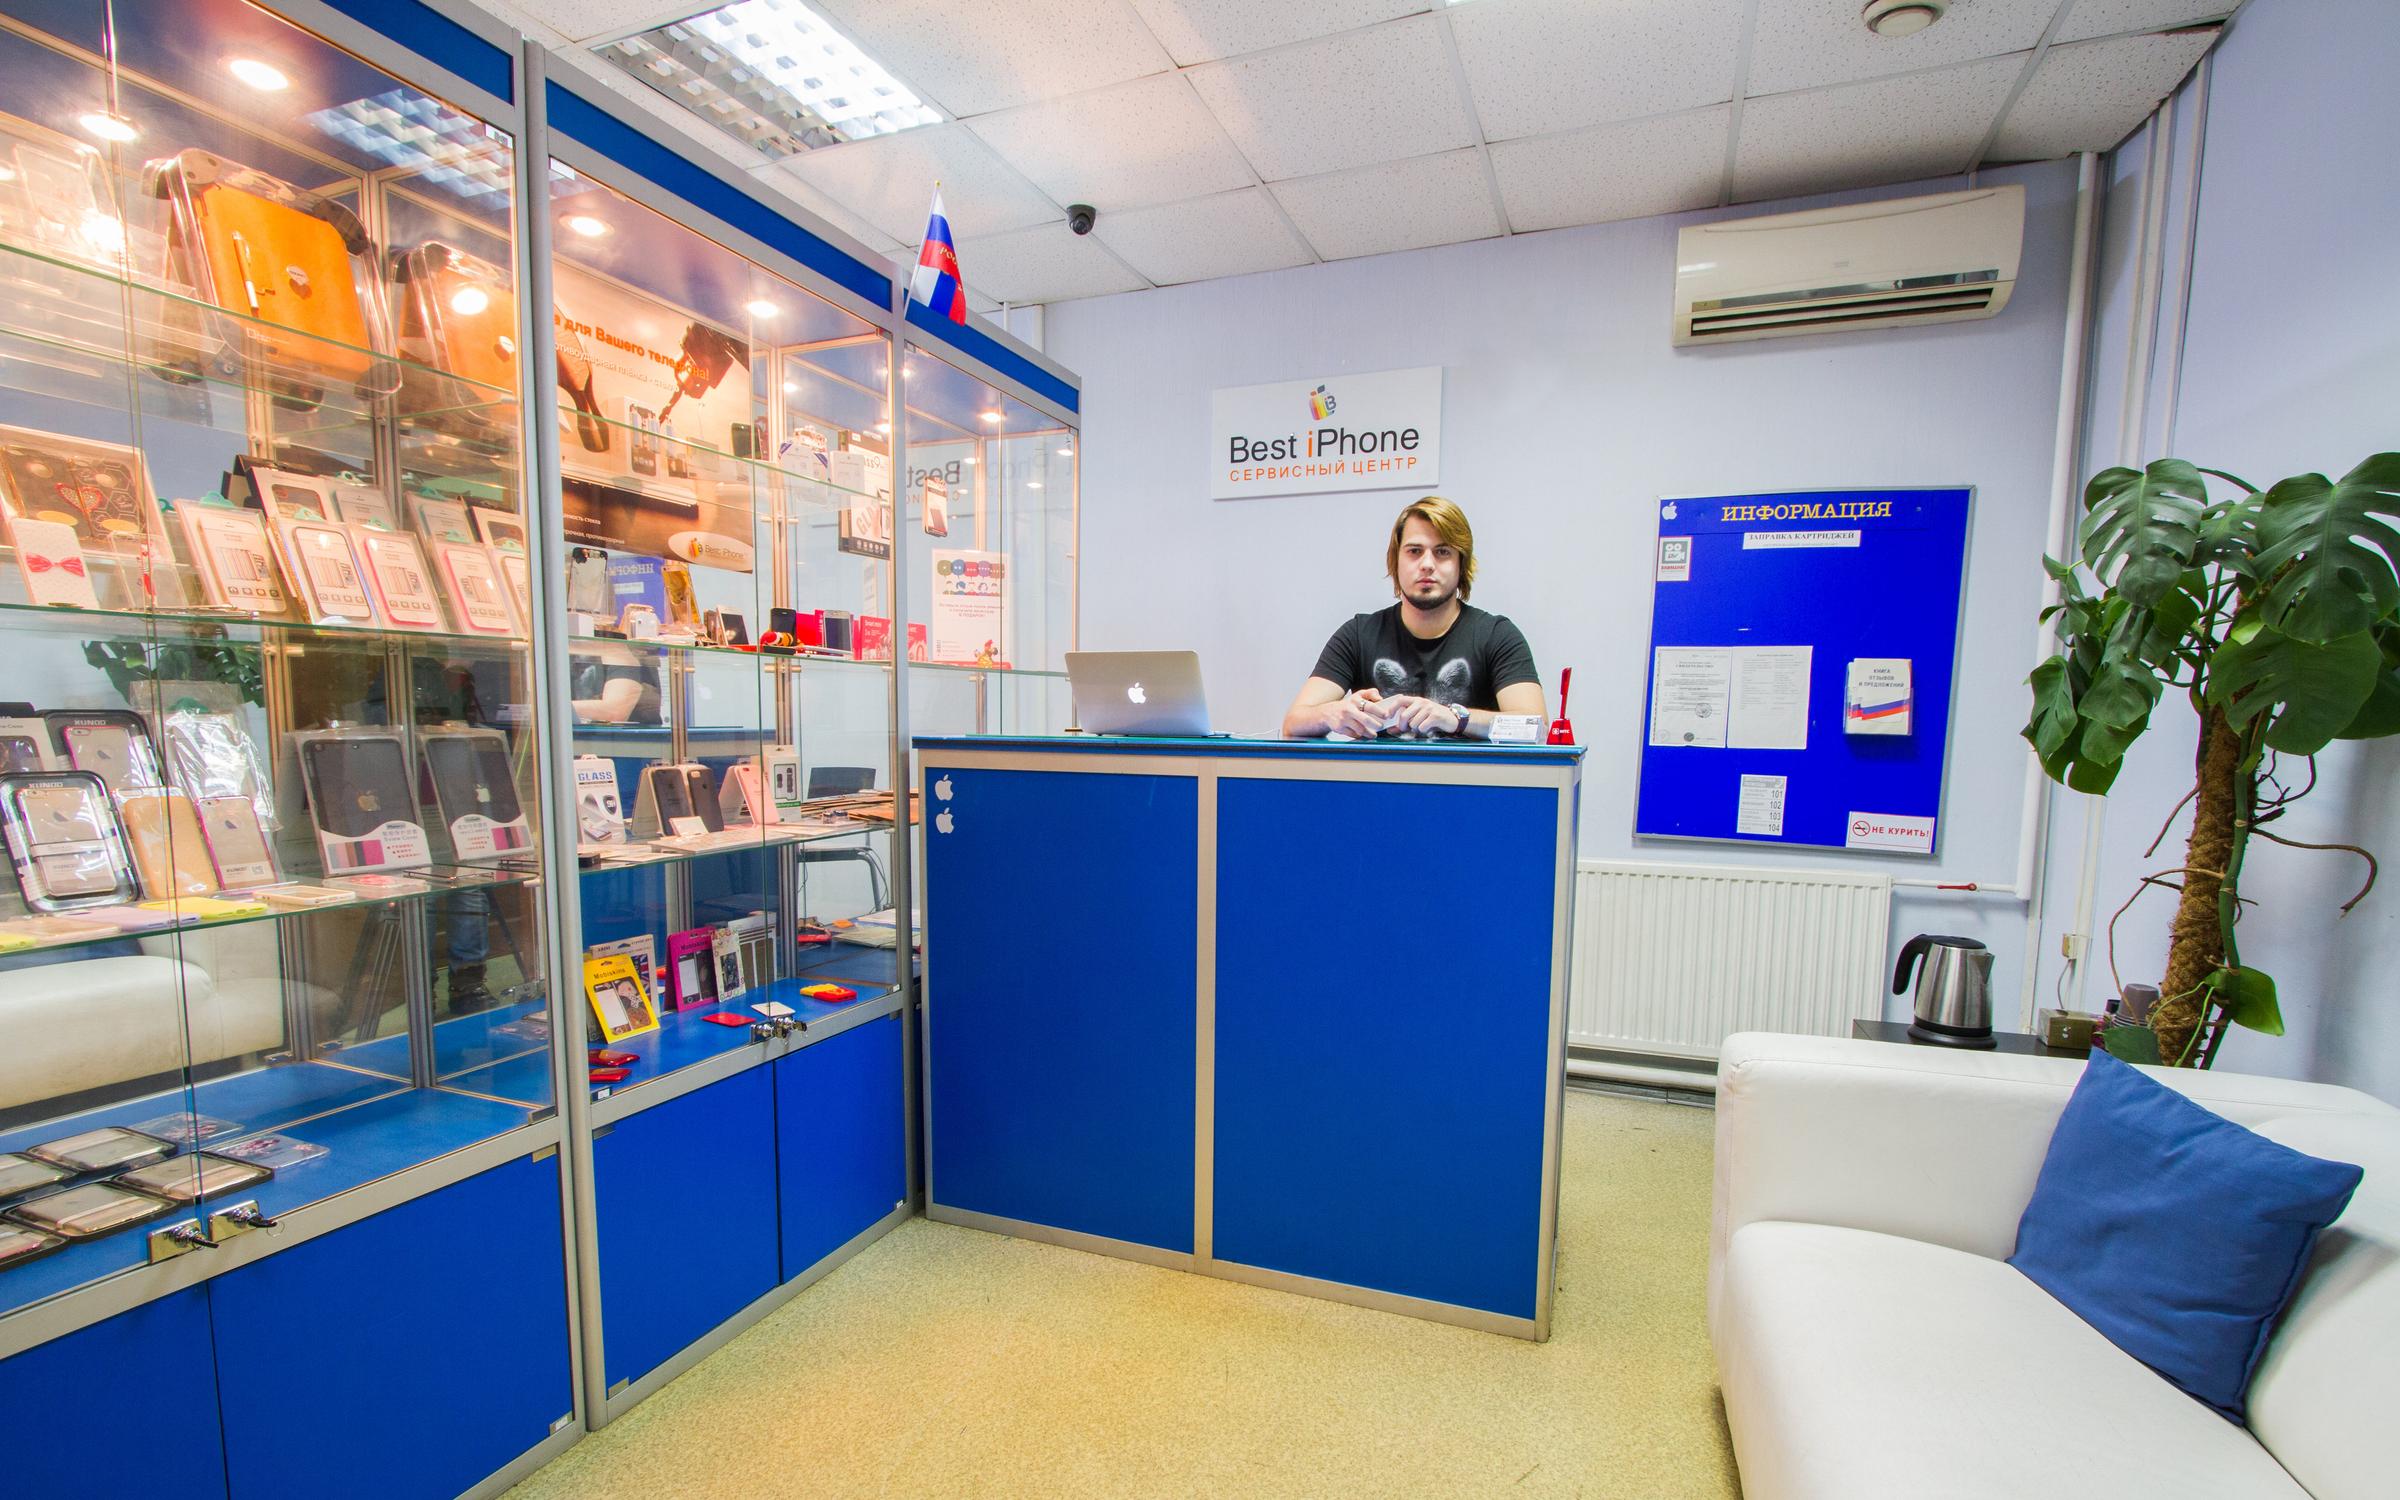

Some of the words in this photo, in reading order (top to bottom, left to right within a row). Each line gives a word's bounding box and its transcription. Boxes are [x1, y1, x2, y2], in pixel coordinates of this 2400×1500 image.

[565, 318, 592, 336] для
[595, 326, 646, 357] Вашего
[648, 349, 711, 382] телефона!
[1230, 434, 1298, 464] Best
[1307, 427, 1420, 458] iPhone
[1230, 459, 1346, 482] СЕРВИСНЫЙ
[1352, 457, 1418, 476] ЦЕНТР
[1720, 501, 1893, 522] ИНФОРМАЦИЯ
[1749, 533, 1793, 541] ЗАПРАВКА
[1794, 531, 1855, 540] КАРТРИДЖЕЙ
[578, 771, 613, 782] GLASS
[1771, 790, 1783, 798] 101
[1770, 801, 1782, 809] 102
[1769, 812, 1781, 821] 103
[1768, 823, 1780, 832] 104
[1872, 826, 1885, 834] НЕ
[1888, 827, 1929, 837] КУРИТЬ!
[593, 968, 626, 980] Mobiskins
